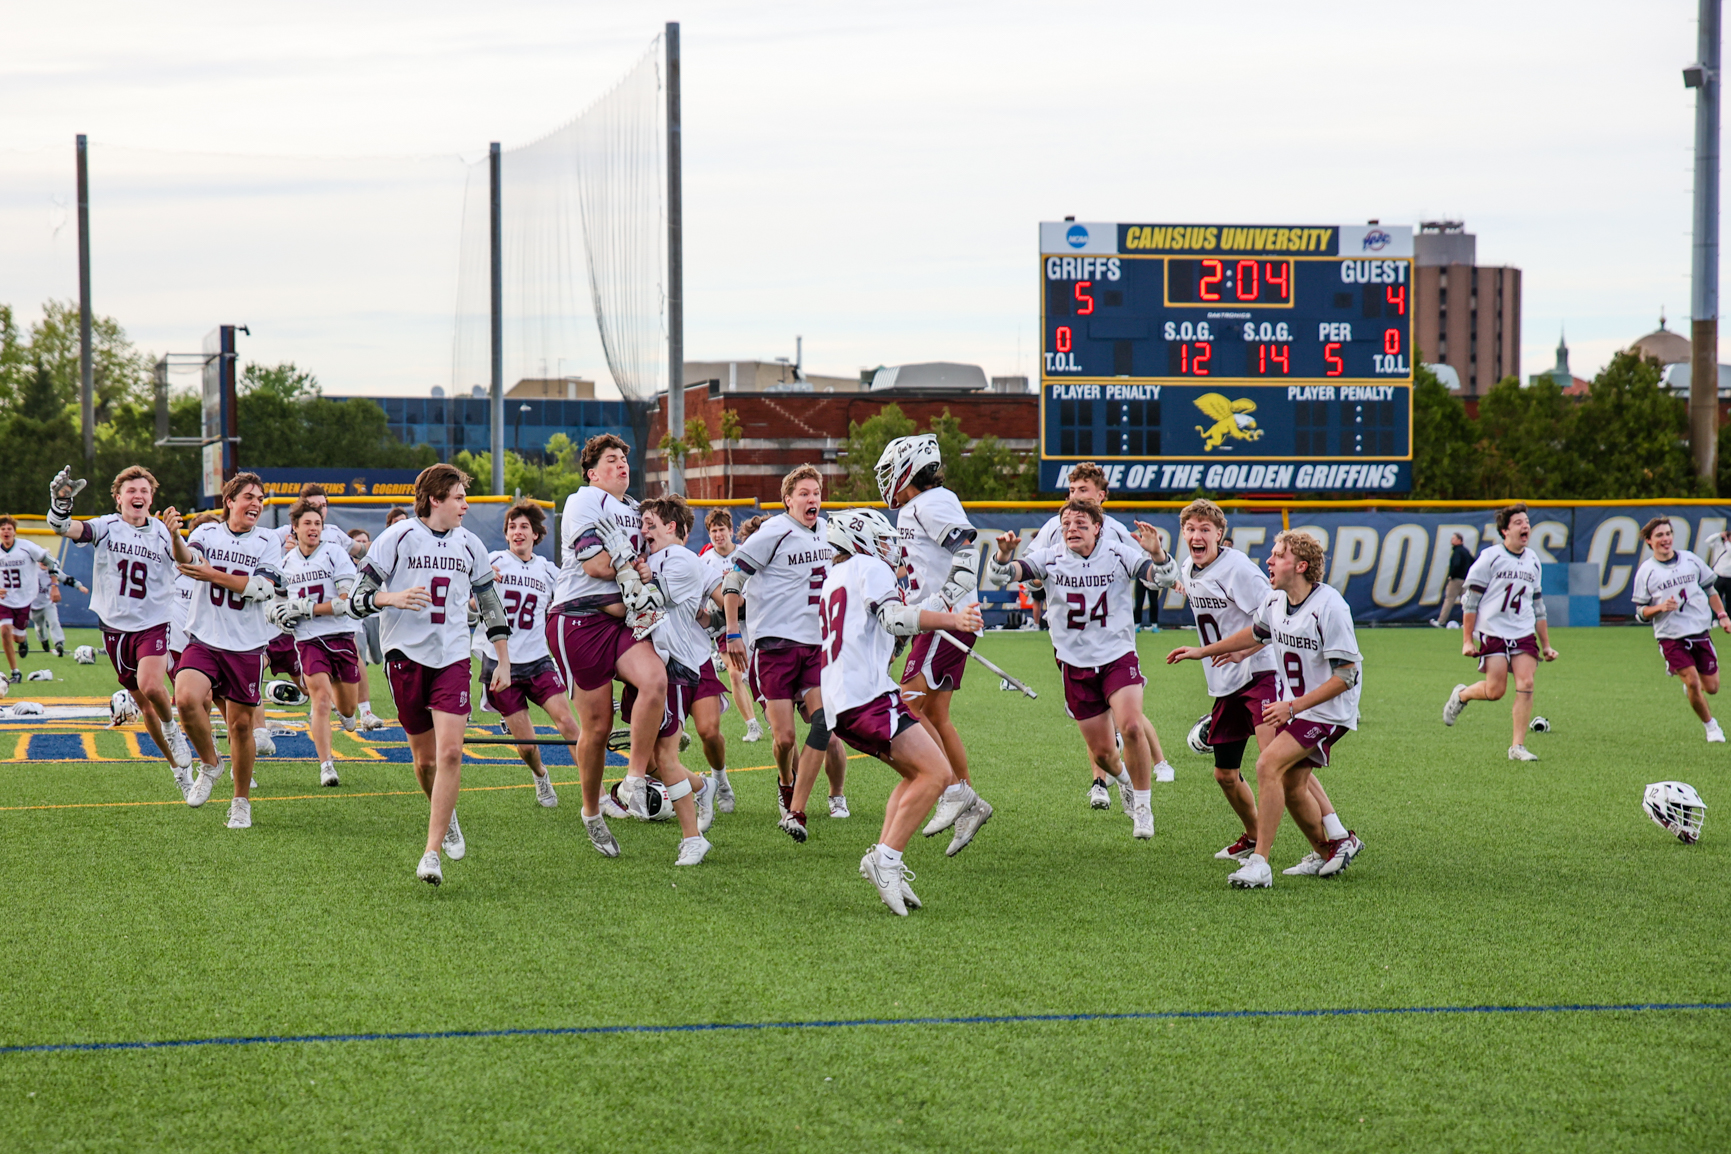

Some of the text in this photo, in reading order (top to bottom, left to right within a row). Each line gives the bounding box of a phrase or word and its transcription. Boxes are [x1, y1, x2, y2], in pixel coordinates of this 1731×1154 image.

[1125, 226, 1333, 251] CANISIUS UNIVERSITY
[1046, 256, 1121, 281] GRIFFS
[1199, 258, 1289, 301] 2:04
[1340, 259, 1409, 284] GUEST
[1074, 281, 1095, 315] 5
[1386, 285, 1405, 315] 4
[1055, 325, 1072, 353] 0
[1164, 321, 1214, 341] S.O.G.
[1243, 322, 1293, 342] S.O.G.
[1318, 322, 1351, 342] PER
[1383, 328, 1400, 355] 0
[1044, 352, 1083, 372] T.O.L.
[1181, 341, 1212, 376] 12
[1258, 343, 1290, 374] 14
[1324, 342, 1344, 376] 5
[1372, 354, 1410, 374] T.O.L.
[1052, 384, 1161, 400] PLAYER PENALTY
[1287, 385, 1395, 401] PLAYER PENALTY
[263, 482, 302, 494] GOLDEN
[1055, 464, 1399, 490] HME OF THE GOLDEN GRIFFINS
[849, 517, 865, 532] 29
[2, 568, 21, 589] 33
[117, 558, 148, 600] 19
[430, 576, 451, 625] 9
[503, 589, 538, 631] 28
[1066, 590, 1109, 631] 24
[1500, 582, 1527, 616] 14
[1648, 787, 1660, 799] 12
